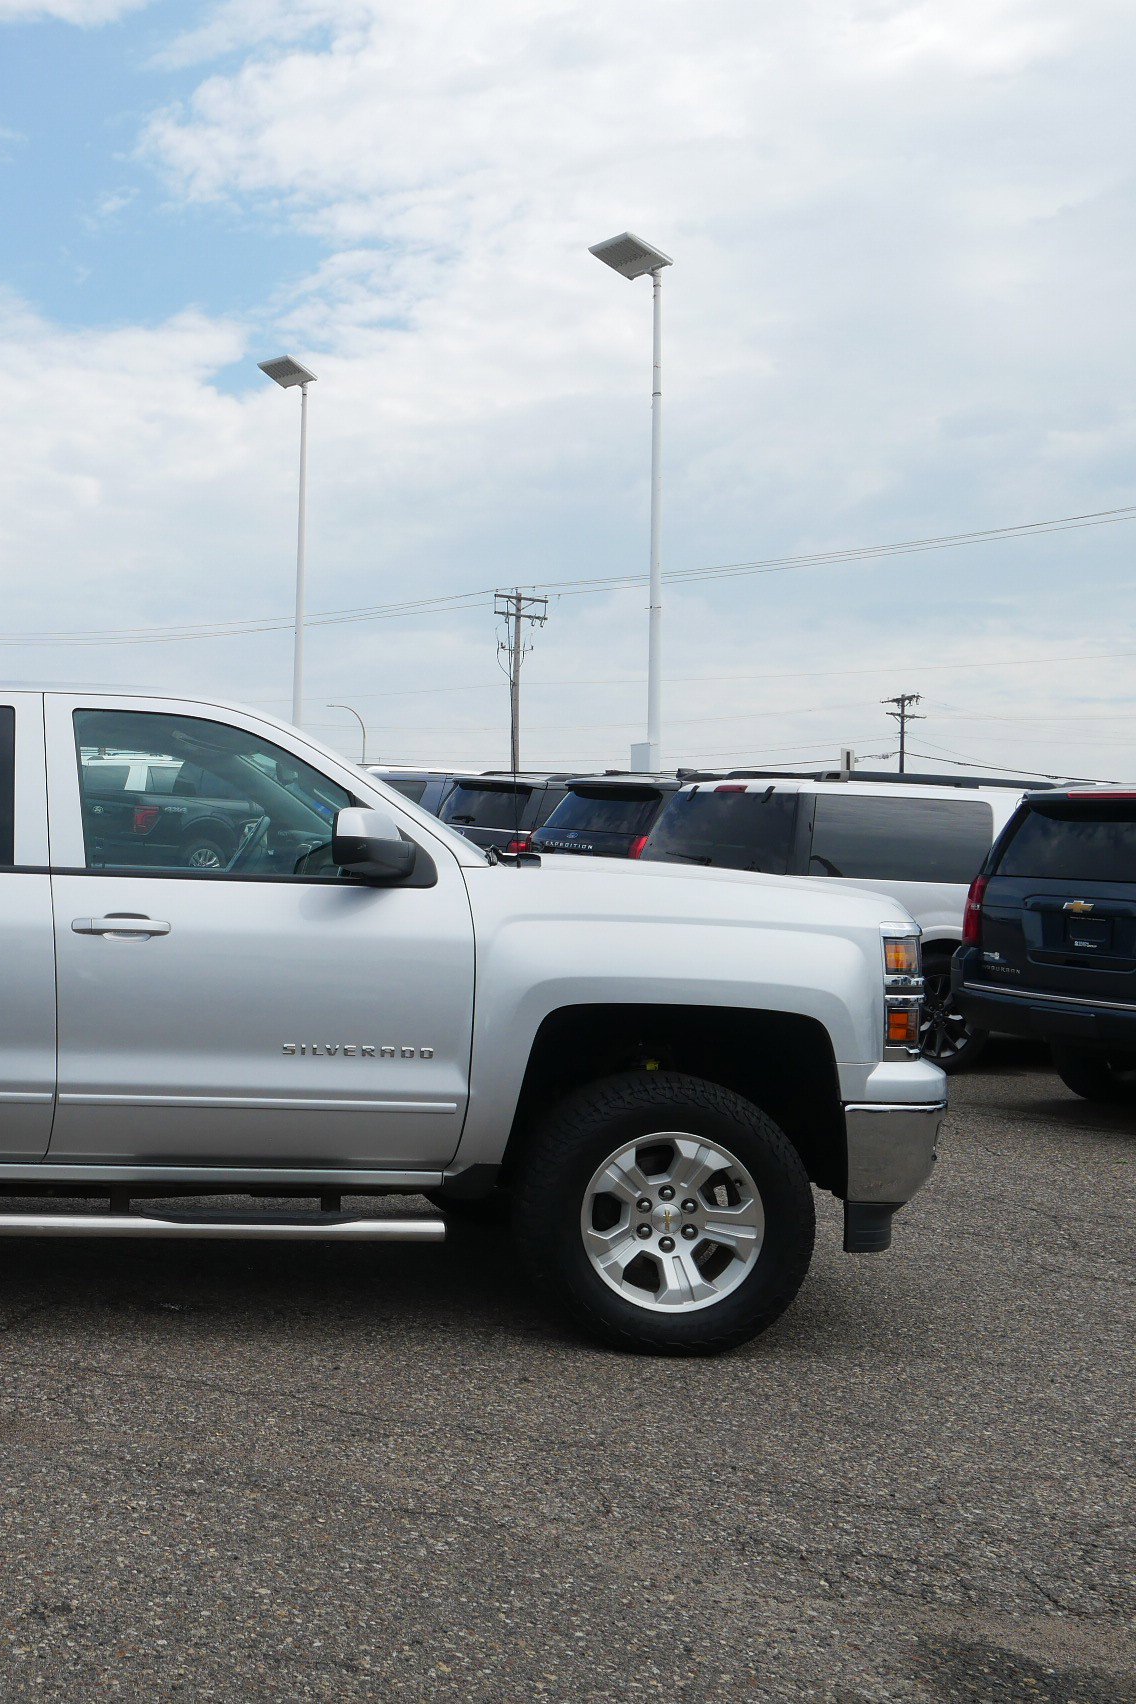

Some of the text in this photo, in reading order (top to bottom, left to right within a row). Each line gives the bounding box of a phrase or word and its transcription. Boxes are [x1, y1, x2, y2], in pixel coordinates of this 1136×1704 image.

[545, 840, 593, 850] EXPEDITION
[981, 964, 1021, 974] UBURBAN
[282, 1043, 434, 1060] SILVERADO
